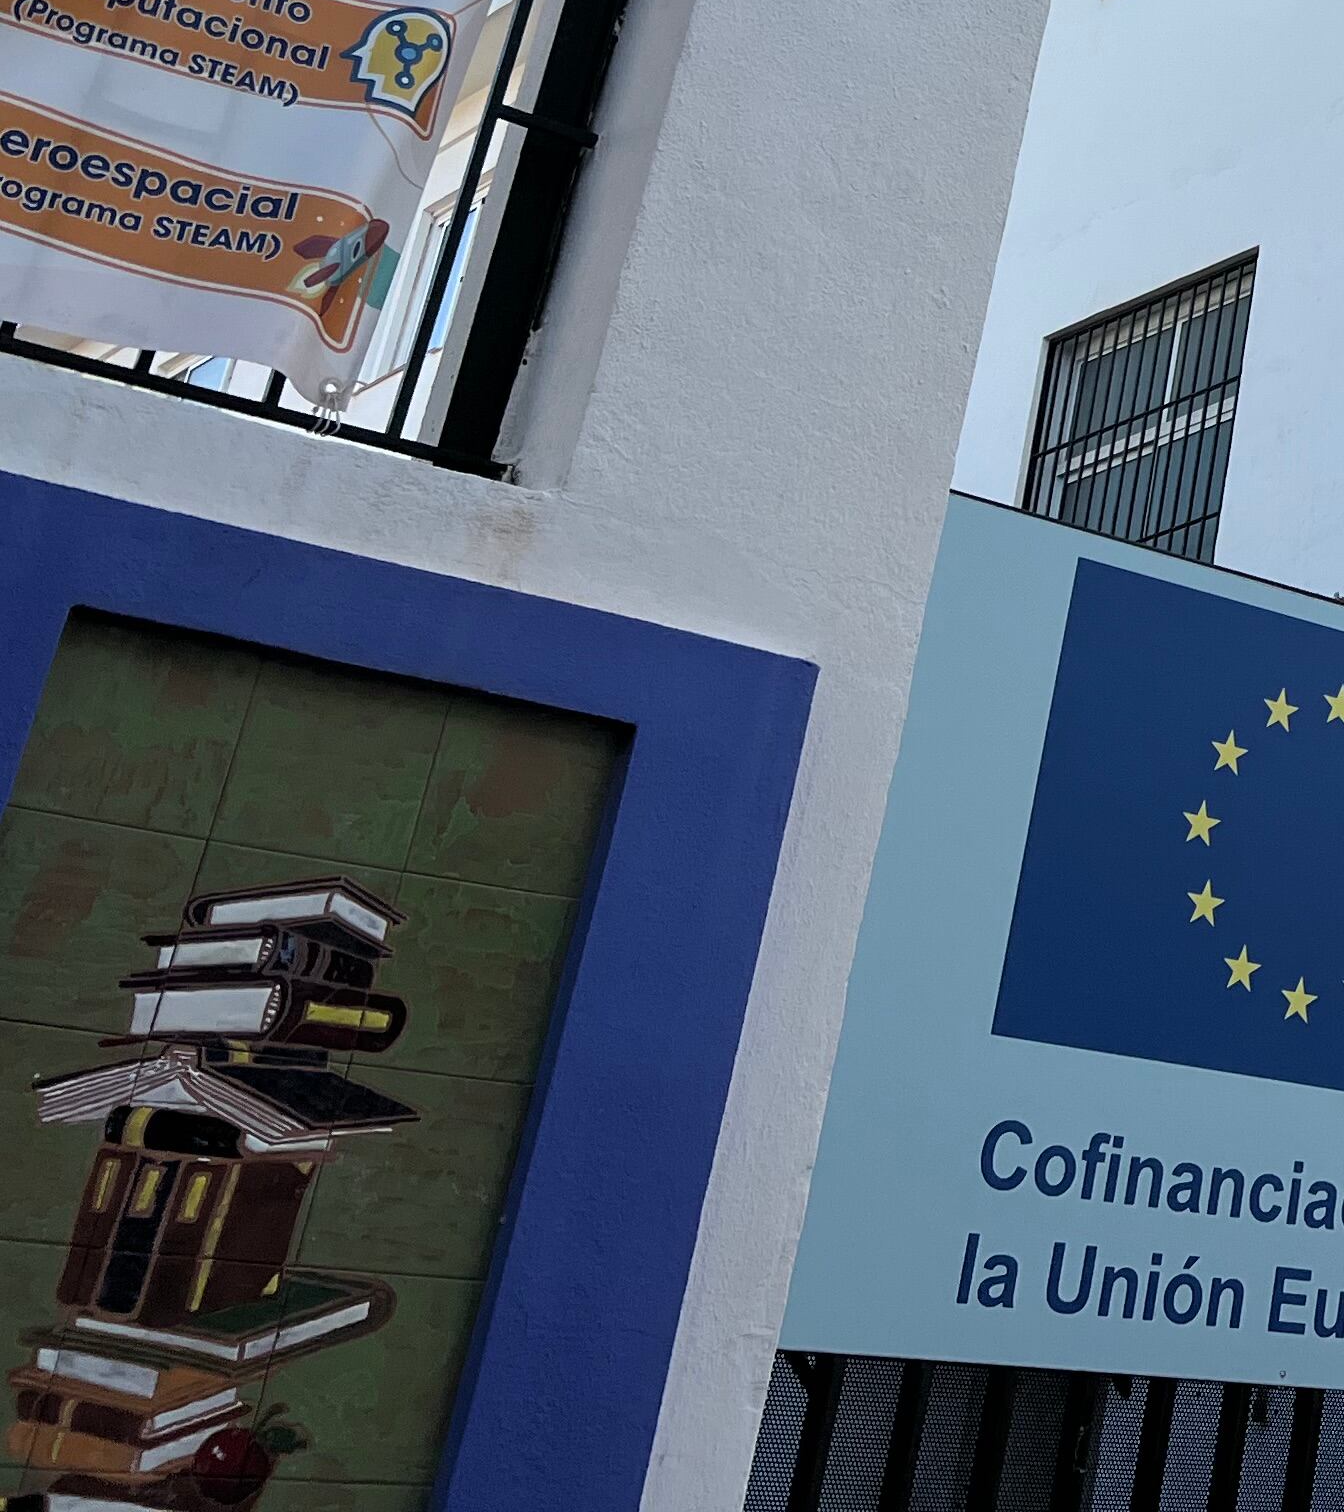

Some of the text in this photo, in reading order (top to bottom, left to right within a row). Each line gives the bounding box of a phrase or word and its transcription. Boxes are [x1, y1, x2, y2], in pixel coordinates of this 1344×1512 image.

[187, 53, 299, 107] STEAM)
[0, 129, 300, 220] eroespacial
[0, 175, 283, 261] ograma STEAM)
[955, 1232, 1019, 1309] la
[1045, 1241, 1245, 1329] Unión
